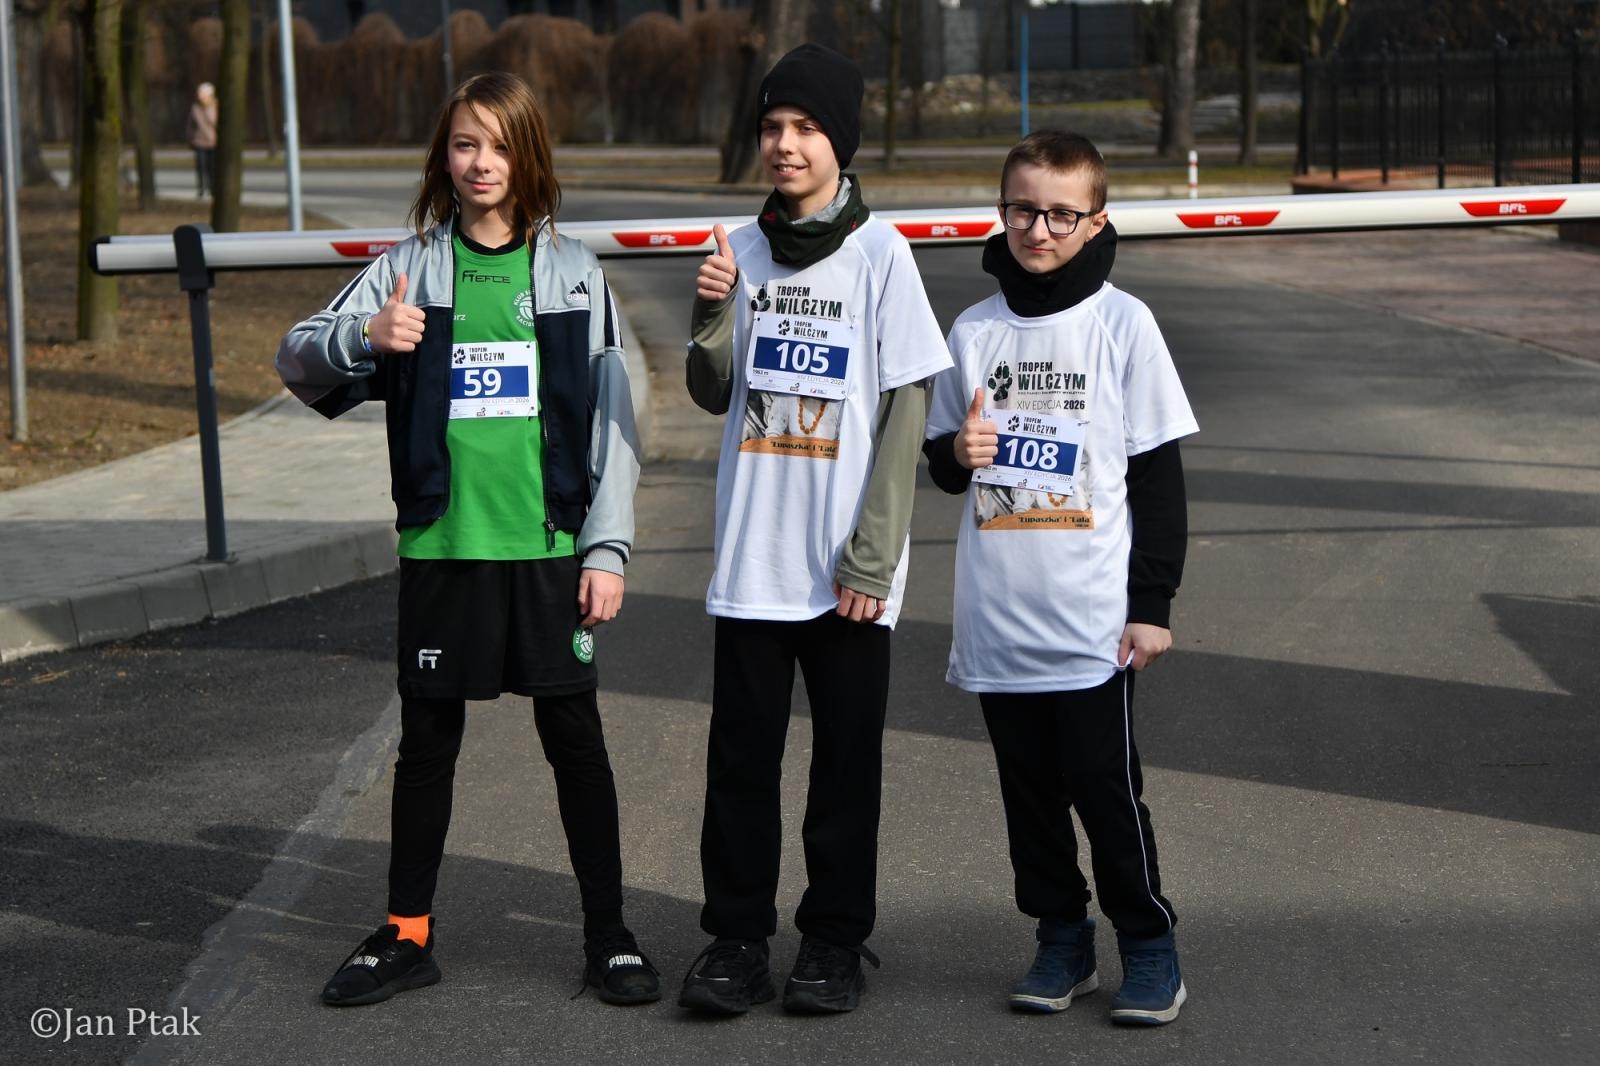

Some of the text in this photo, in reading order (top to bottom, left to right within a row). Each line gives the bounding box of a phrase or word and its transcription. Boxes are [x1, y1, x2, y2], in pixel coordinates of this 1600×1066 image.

[777, 286, 811, 297] TROPEM
[775, 298, 842, 318] WILCZYM
[793, 327, 828, 339] WILCZYM
[469, 352, 505, 362] WILCZYM
[776, 341, 829, 374] 105
[1018, 361, 1053, 372] TROPEM
[464, 368, 502, 397] 59
[1017, 373, 1086, 390] WILCZYM
[1017, 400, 1085, 410] XIV EDYCJA 2026
[1023, 423, 1057, 436] WILCZYM
[1005, 438, 1059, 470] 108
[609, 954, 642, 968] PUMA
